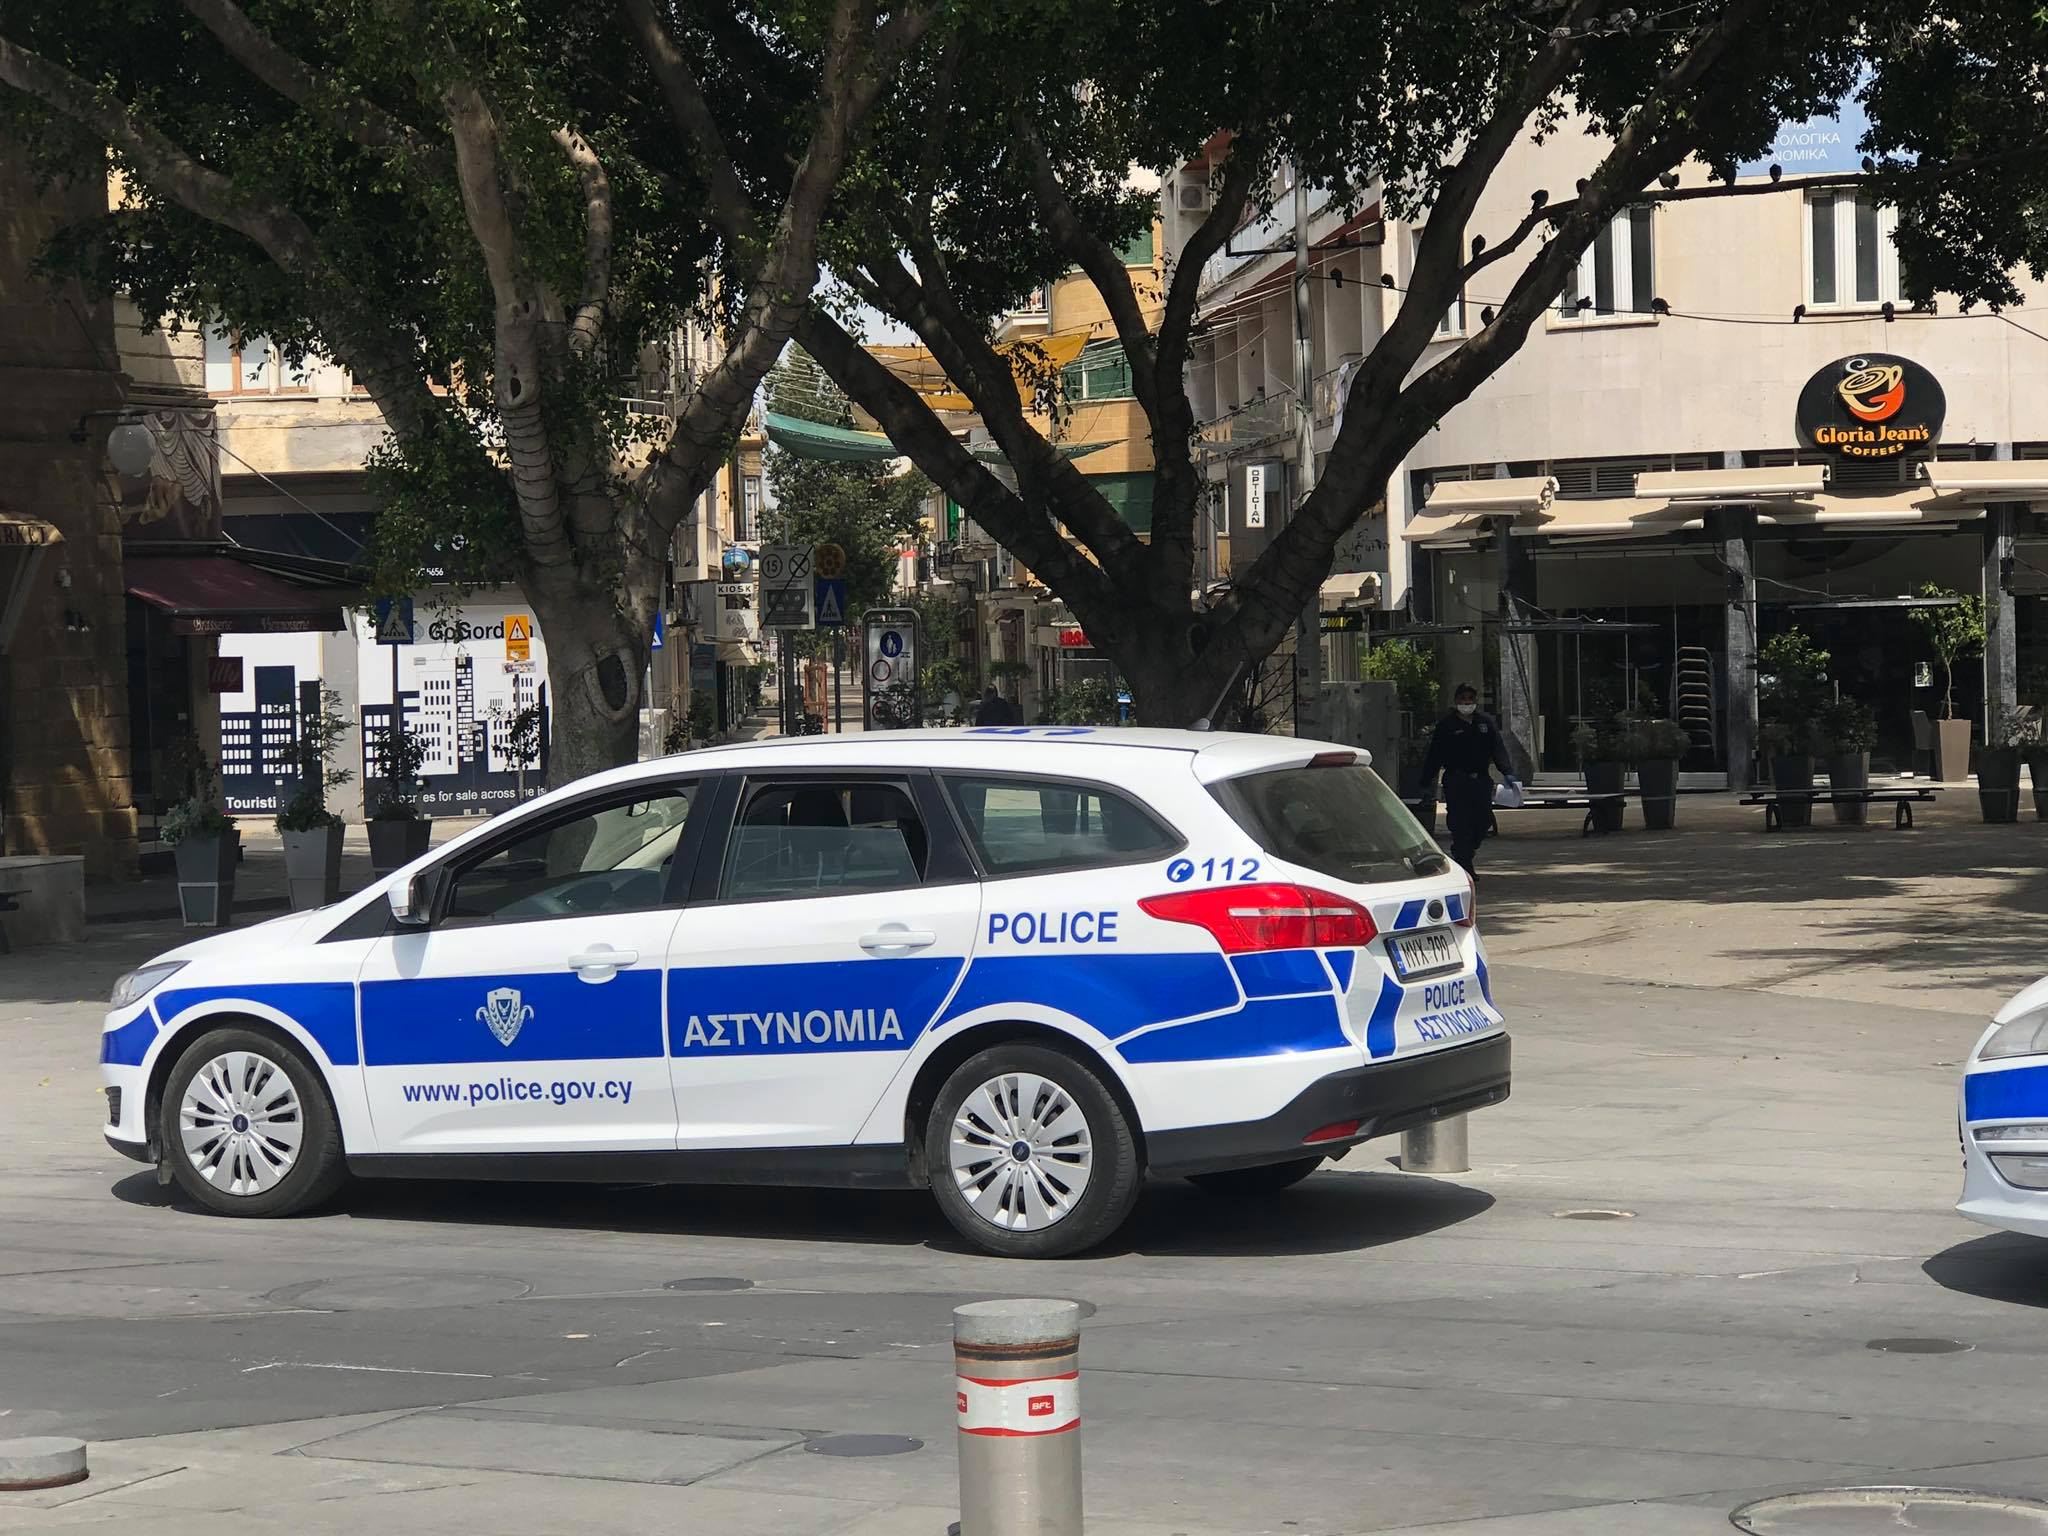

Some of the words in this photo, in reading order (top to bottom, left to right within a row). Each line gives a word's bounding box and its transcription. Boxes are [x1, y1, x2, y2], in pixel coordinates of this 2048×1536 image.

[1816, 426, 1875, 444] Gloria
[1878, 424, 1929, 442] Jean's
[1842, 443, 1905, 456] COFFEES
[1251, 469, 1260, 524] OPTICIAN
[765, 560, 778, 573] 15
[718, 585, 752, 593] KIOSK
[438, 790, 453, 802] for
[455, 789, 478, 801] sale
[480, 788, 516, 800] across
[1201, 857, 1260, 882] 112
[987, 911, 1119, 944] POLICE
[1424, 980, 1466, 1011] POLICE
[683, 1008, 905, 1048] ΑΣΤΥΝΟΜΙΑ
[1413, 1005, 1494, 1042] ΑΣΤΥΝΟΜΙΑ
[402, 1077, 633, 1107] www.police.gov.cy
